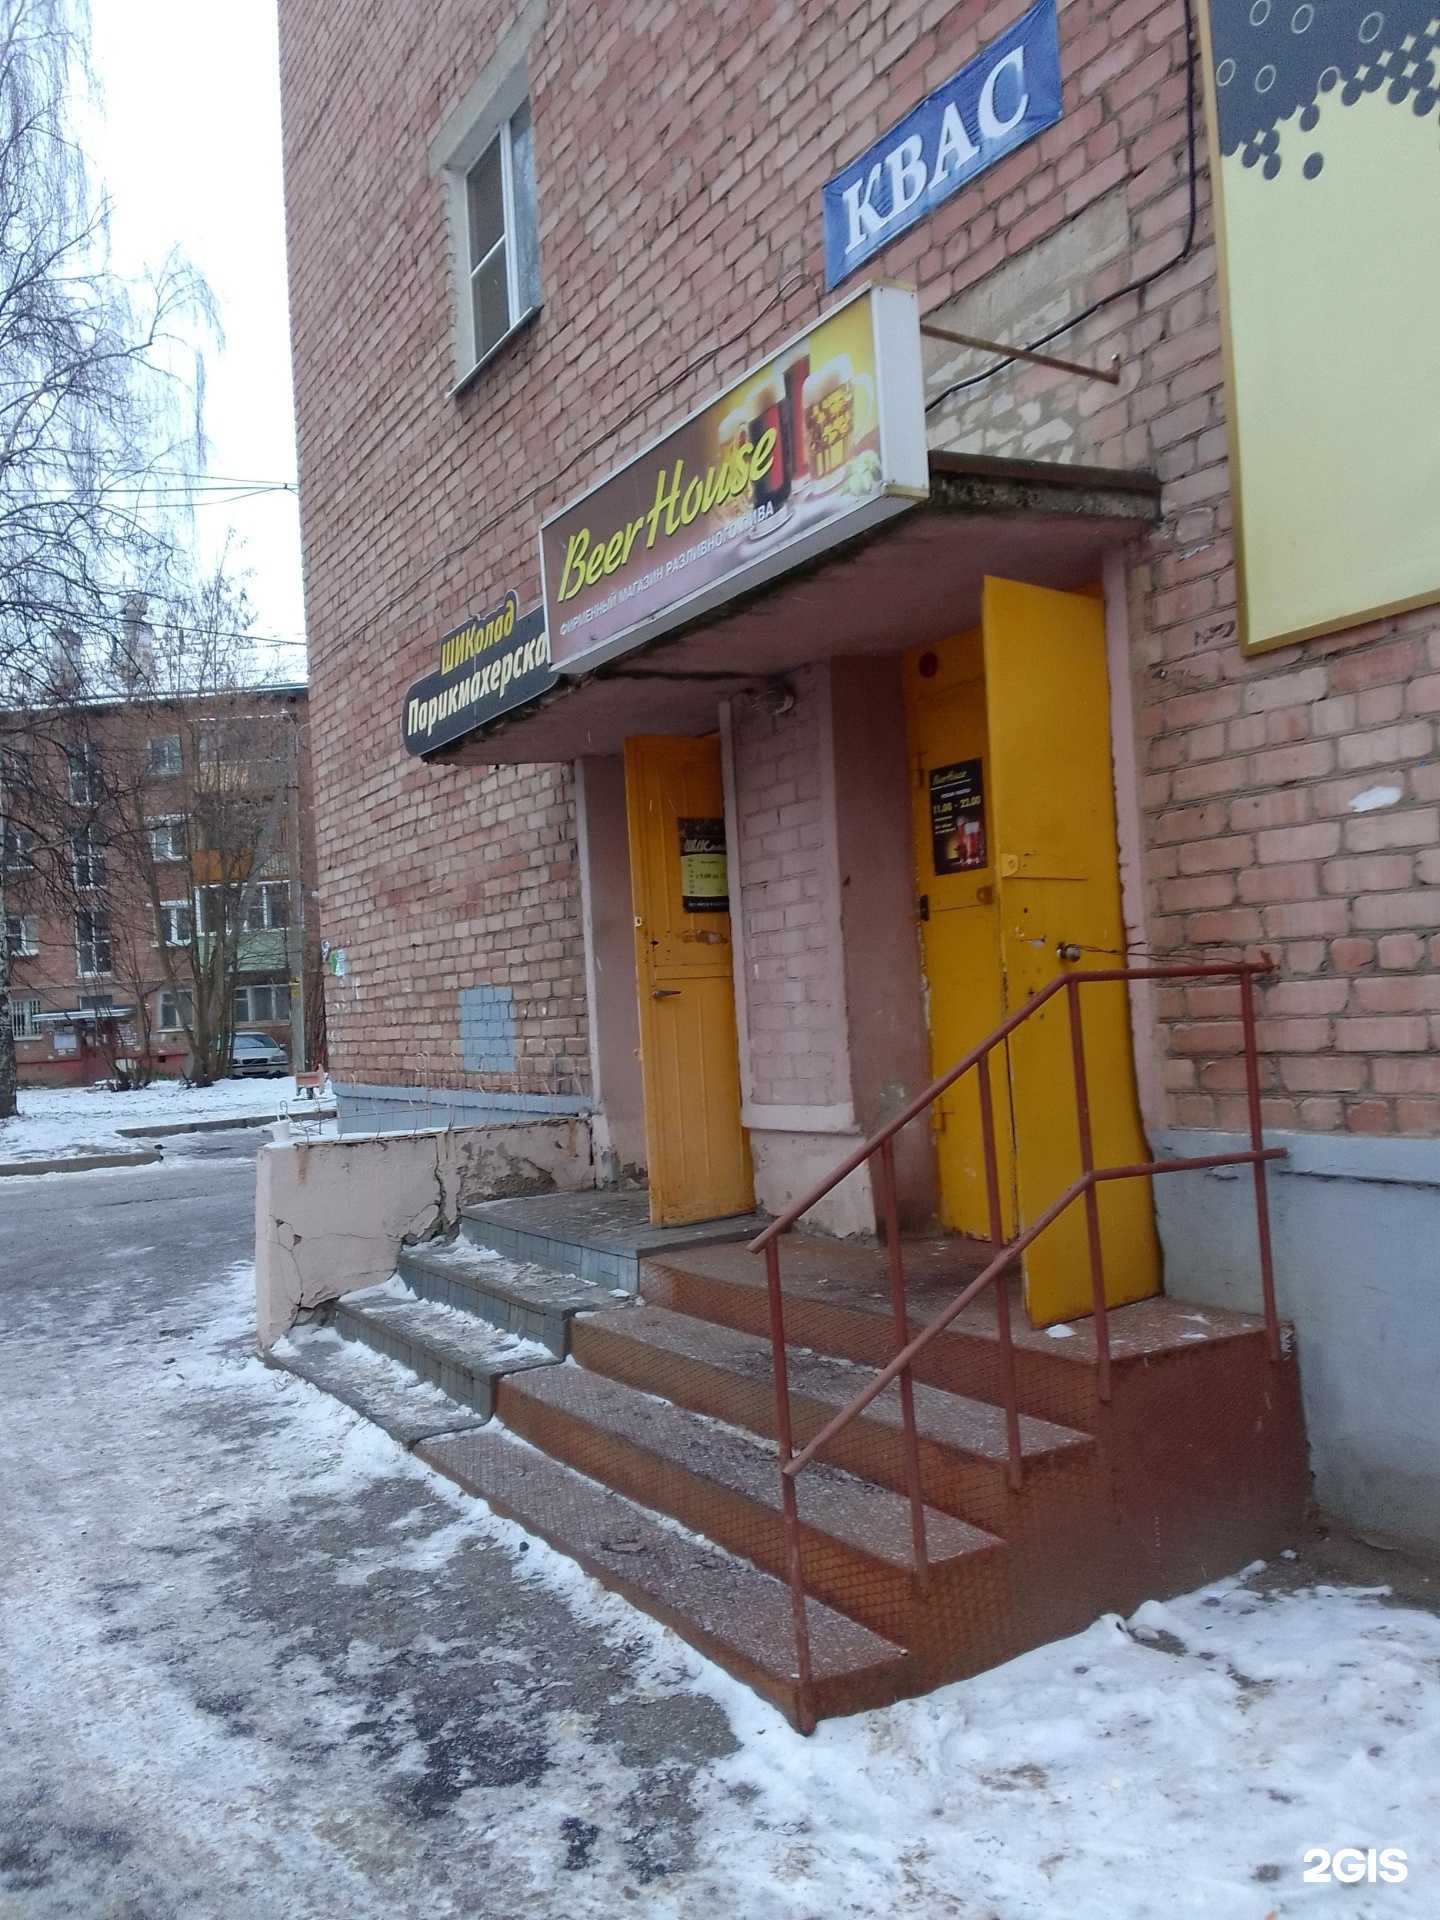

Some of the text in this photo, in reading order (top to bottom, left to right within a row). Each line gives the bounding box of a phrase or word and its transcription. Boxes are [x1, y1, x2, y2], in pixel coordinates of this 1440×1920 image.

[842, 45, 1029, 255] КВАС
[560, 590, 617, 636] ФИРМЕННЫЙ
[618, 564, 664, 602] МАГАЗИН
[665, 521, 738, 575] РАЗЛИВНОГО
[407, 632, 551, 737] Парикмахерска
